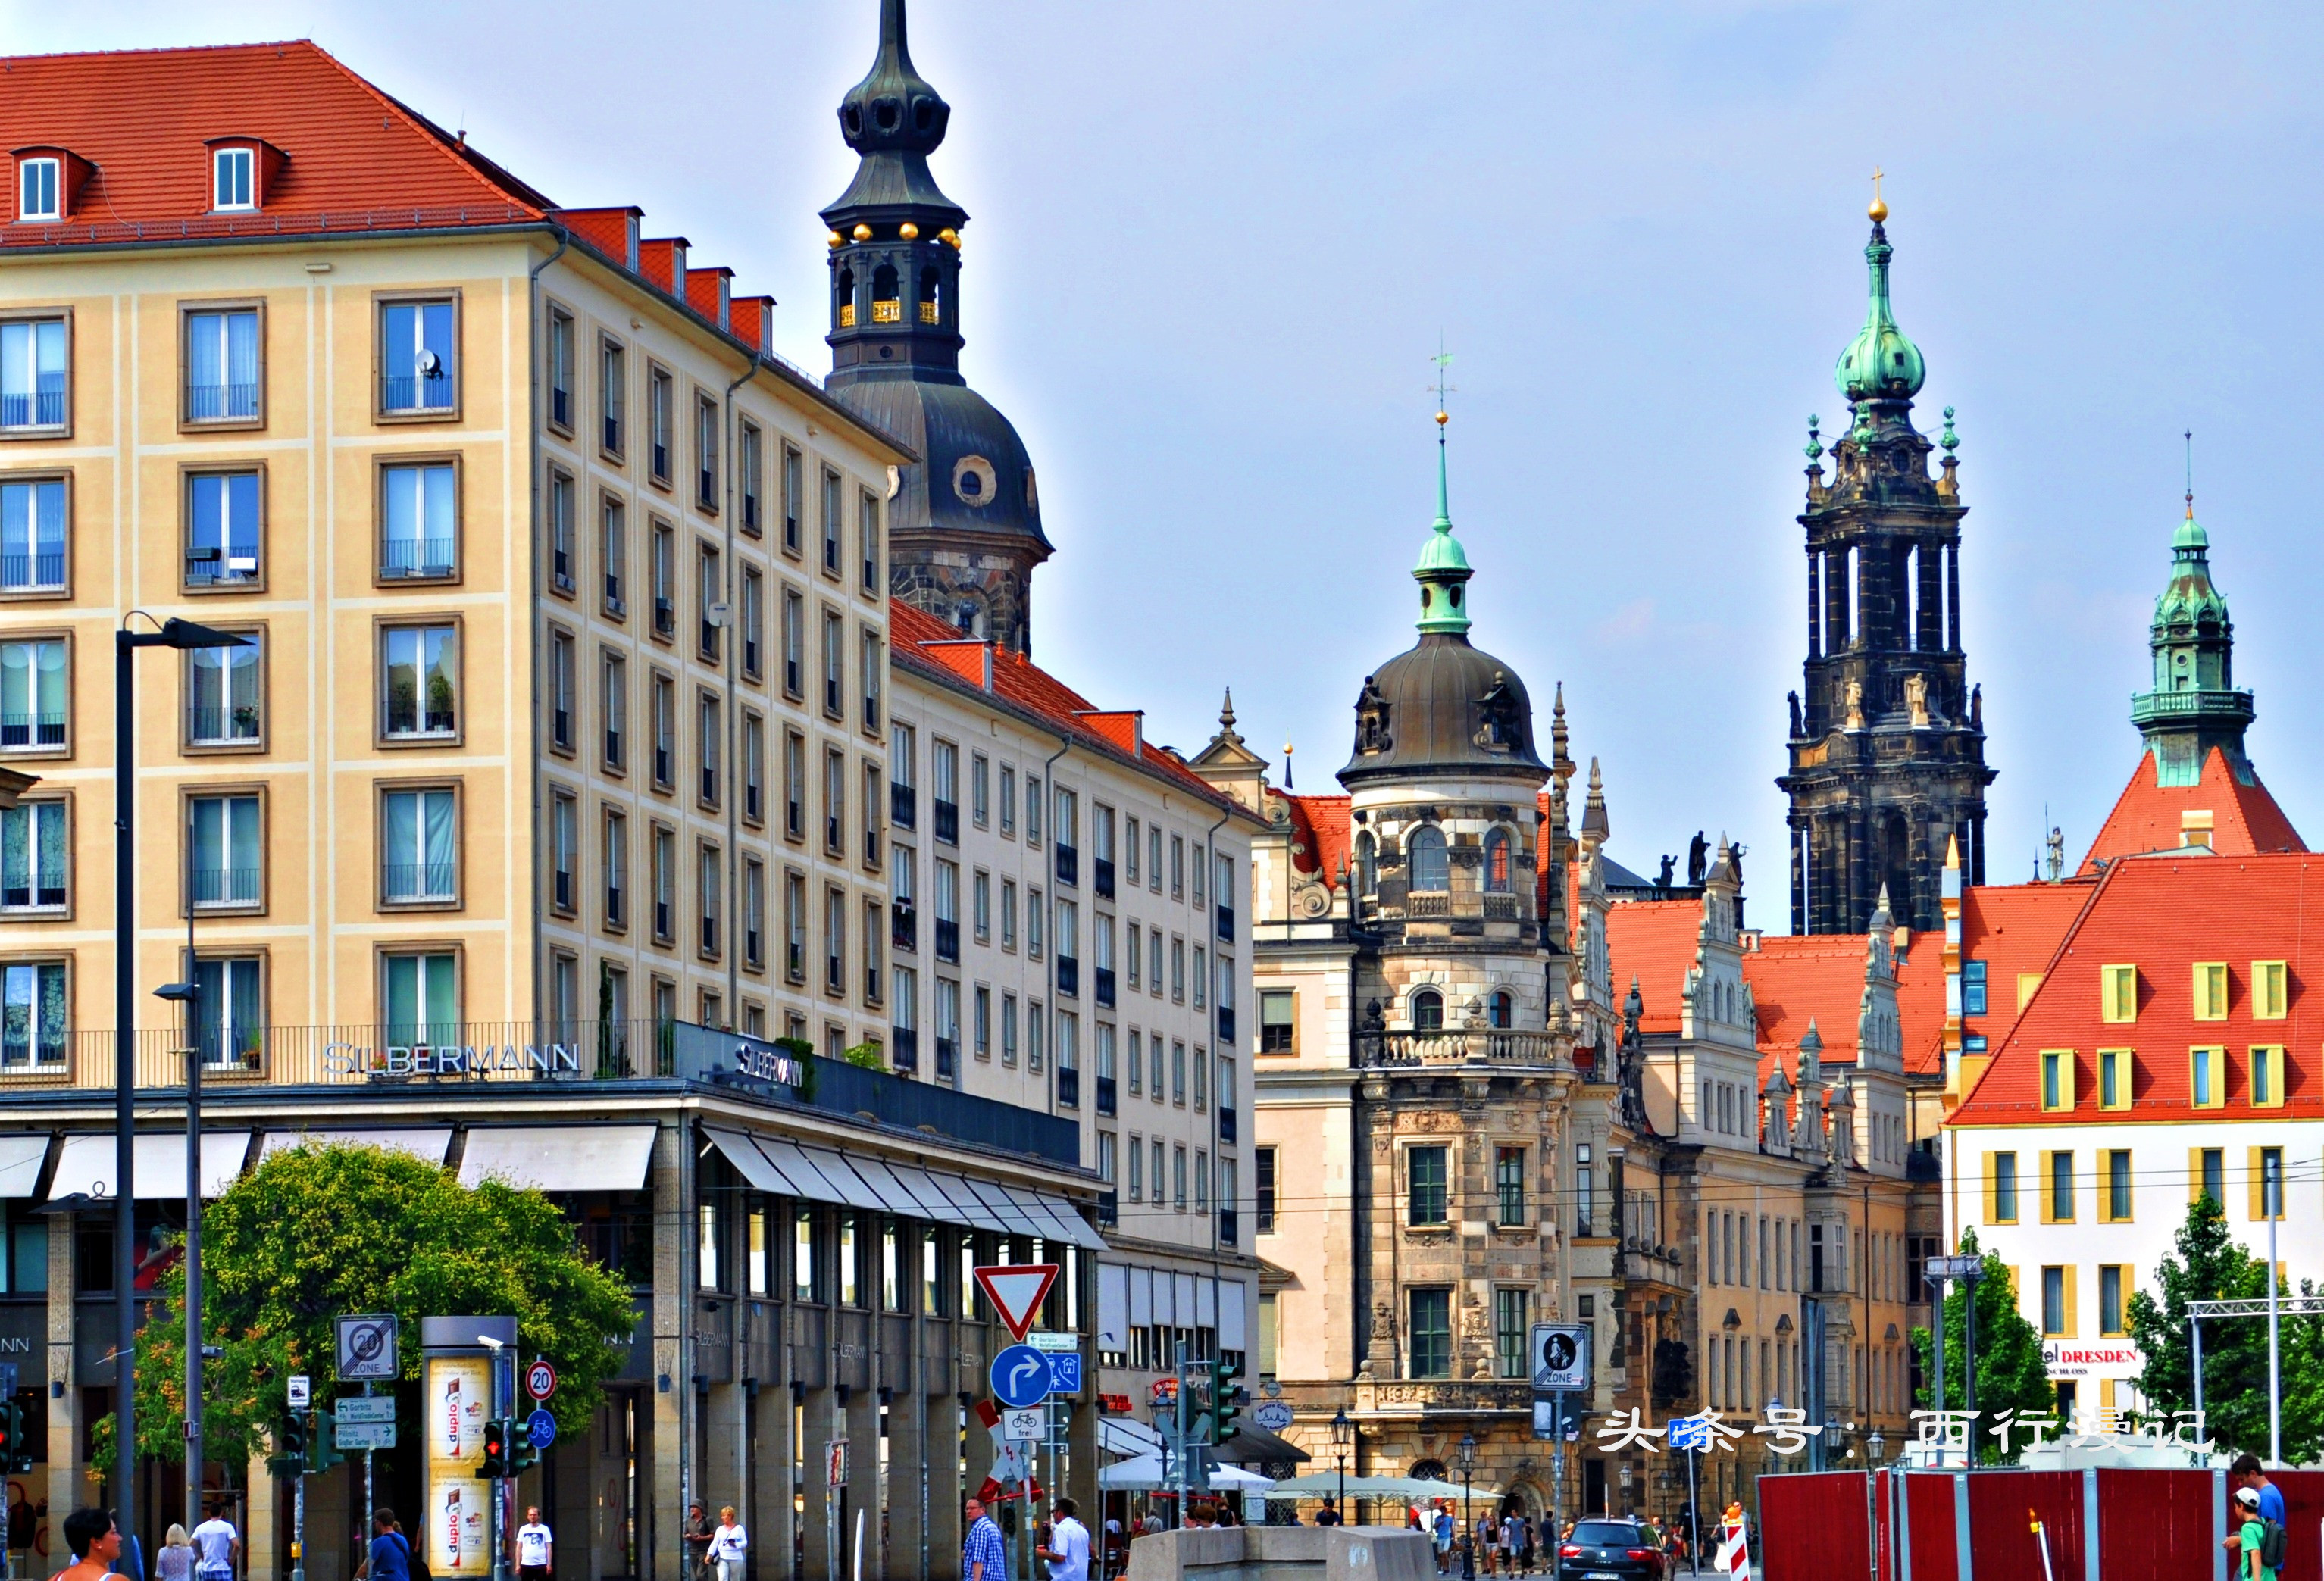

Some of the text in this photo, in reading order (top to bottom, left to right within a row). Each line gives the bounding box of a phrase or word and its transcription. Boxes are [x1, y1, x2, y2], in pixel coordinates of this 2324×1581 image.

[323, 1042, 580, 1074] SILBERMANN
[735, 1042, 802, 1088] SILBERMANN
[357, 1334, 377, 1351] 20
[2062, 1350, 2136, 1363] DRESDEN
[354, 1364, 380, 1373] ZONE
[533, 1372, 549, 1389] 20
[1547, 1373, 1572, 1383] ZONE
[448, 1404, 459, 1442] duplo
[448, 1515, 459, 1553] duplo
